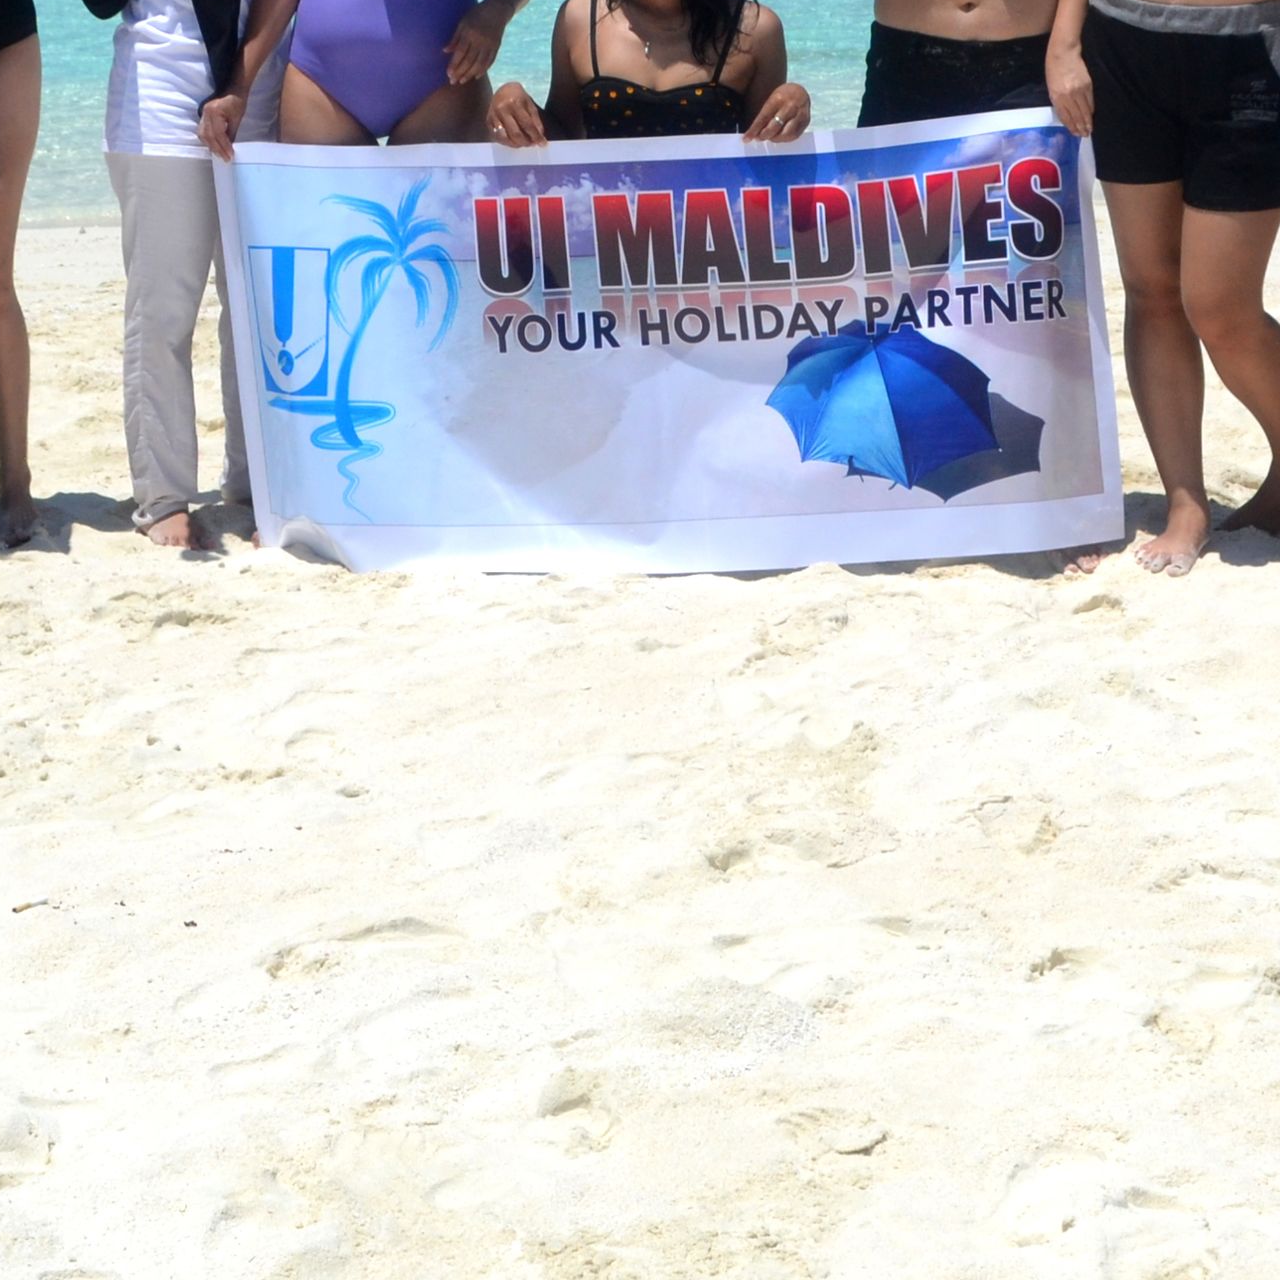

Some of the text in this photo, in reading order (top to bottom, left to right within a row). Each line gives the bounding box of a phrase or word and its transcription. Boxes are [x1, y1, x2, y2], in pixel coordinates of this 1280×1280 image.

[473, 156, 1064, 297] UI MALDIVES
[486, 279, 1067, 353] YOUR HOLIDAY PARTNER
